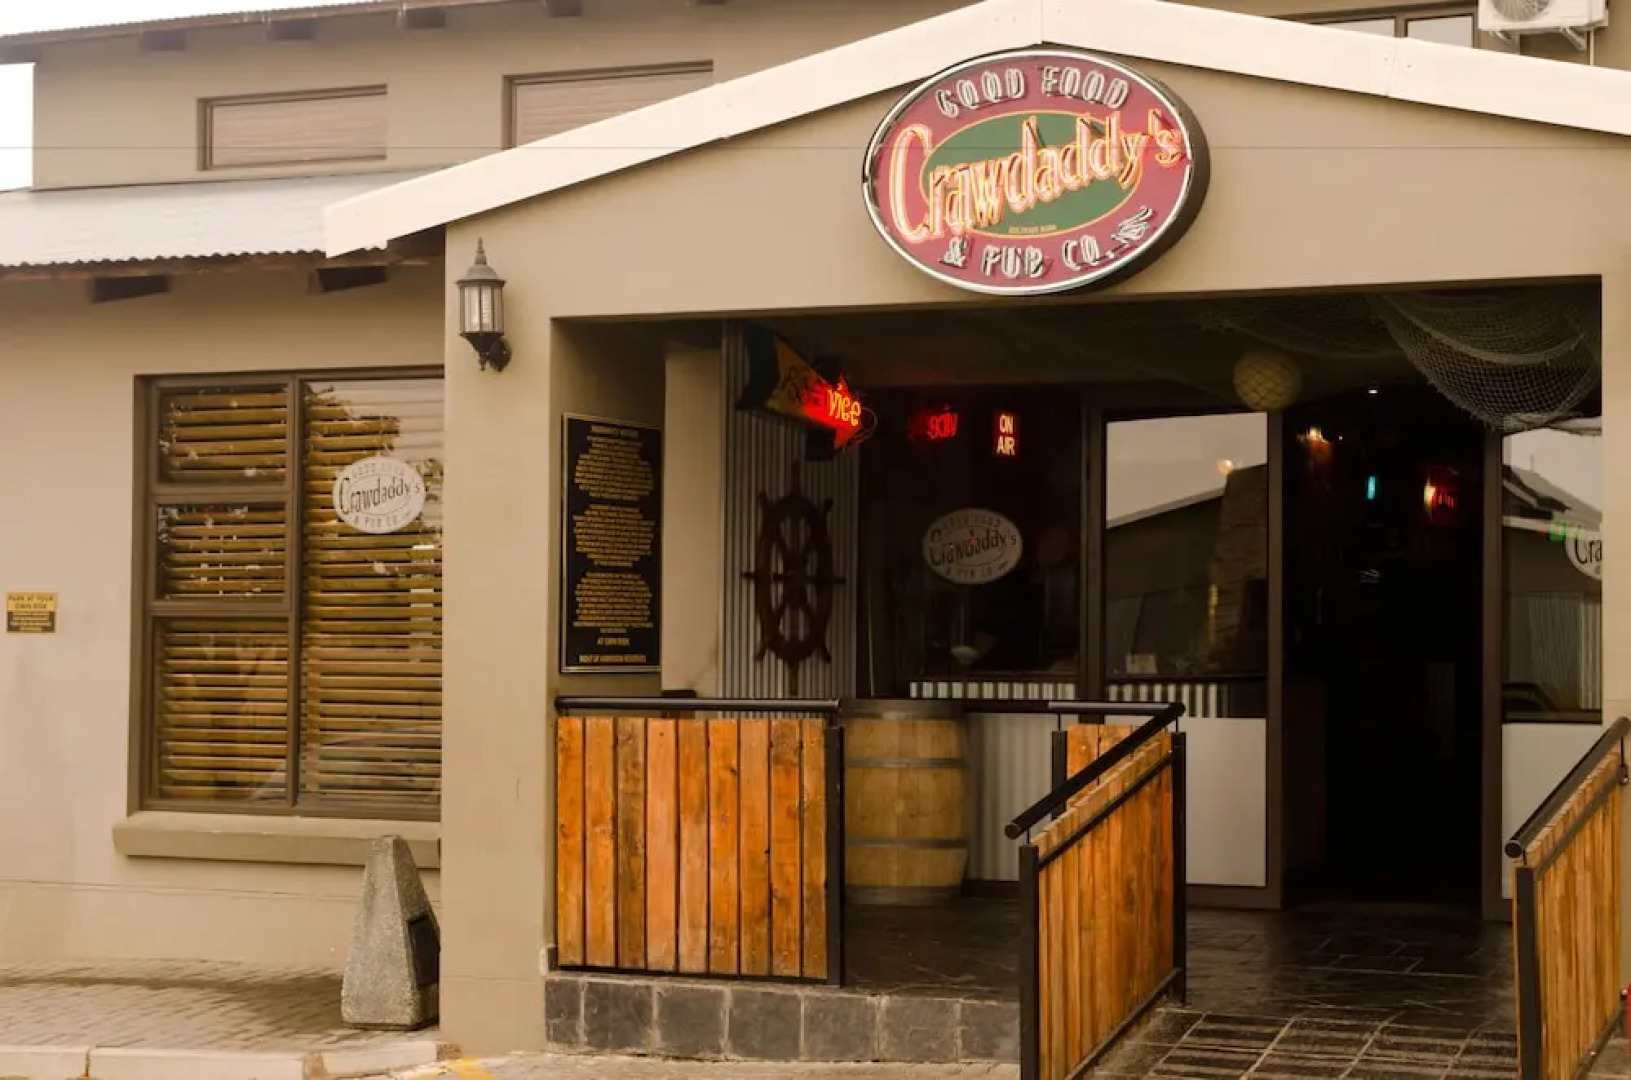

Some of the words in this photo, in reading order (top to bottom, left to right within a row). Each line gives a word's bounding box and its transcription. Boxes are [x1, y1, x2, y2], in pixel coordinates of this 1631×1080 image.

[935, 67, 1026, 118] GOOD
[1040, 65, 1131, 109] FOOD
[889, 109, 1184, 243] Crawdaddy's
[940, 235, 968, 268] &
[981, 244, 1046, 279] PUB
[999, 414, 1014, 434] ON
[996, 436, 1016, 456] AIR
[339, 476, 420, 515] Crawdaddy's
